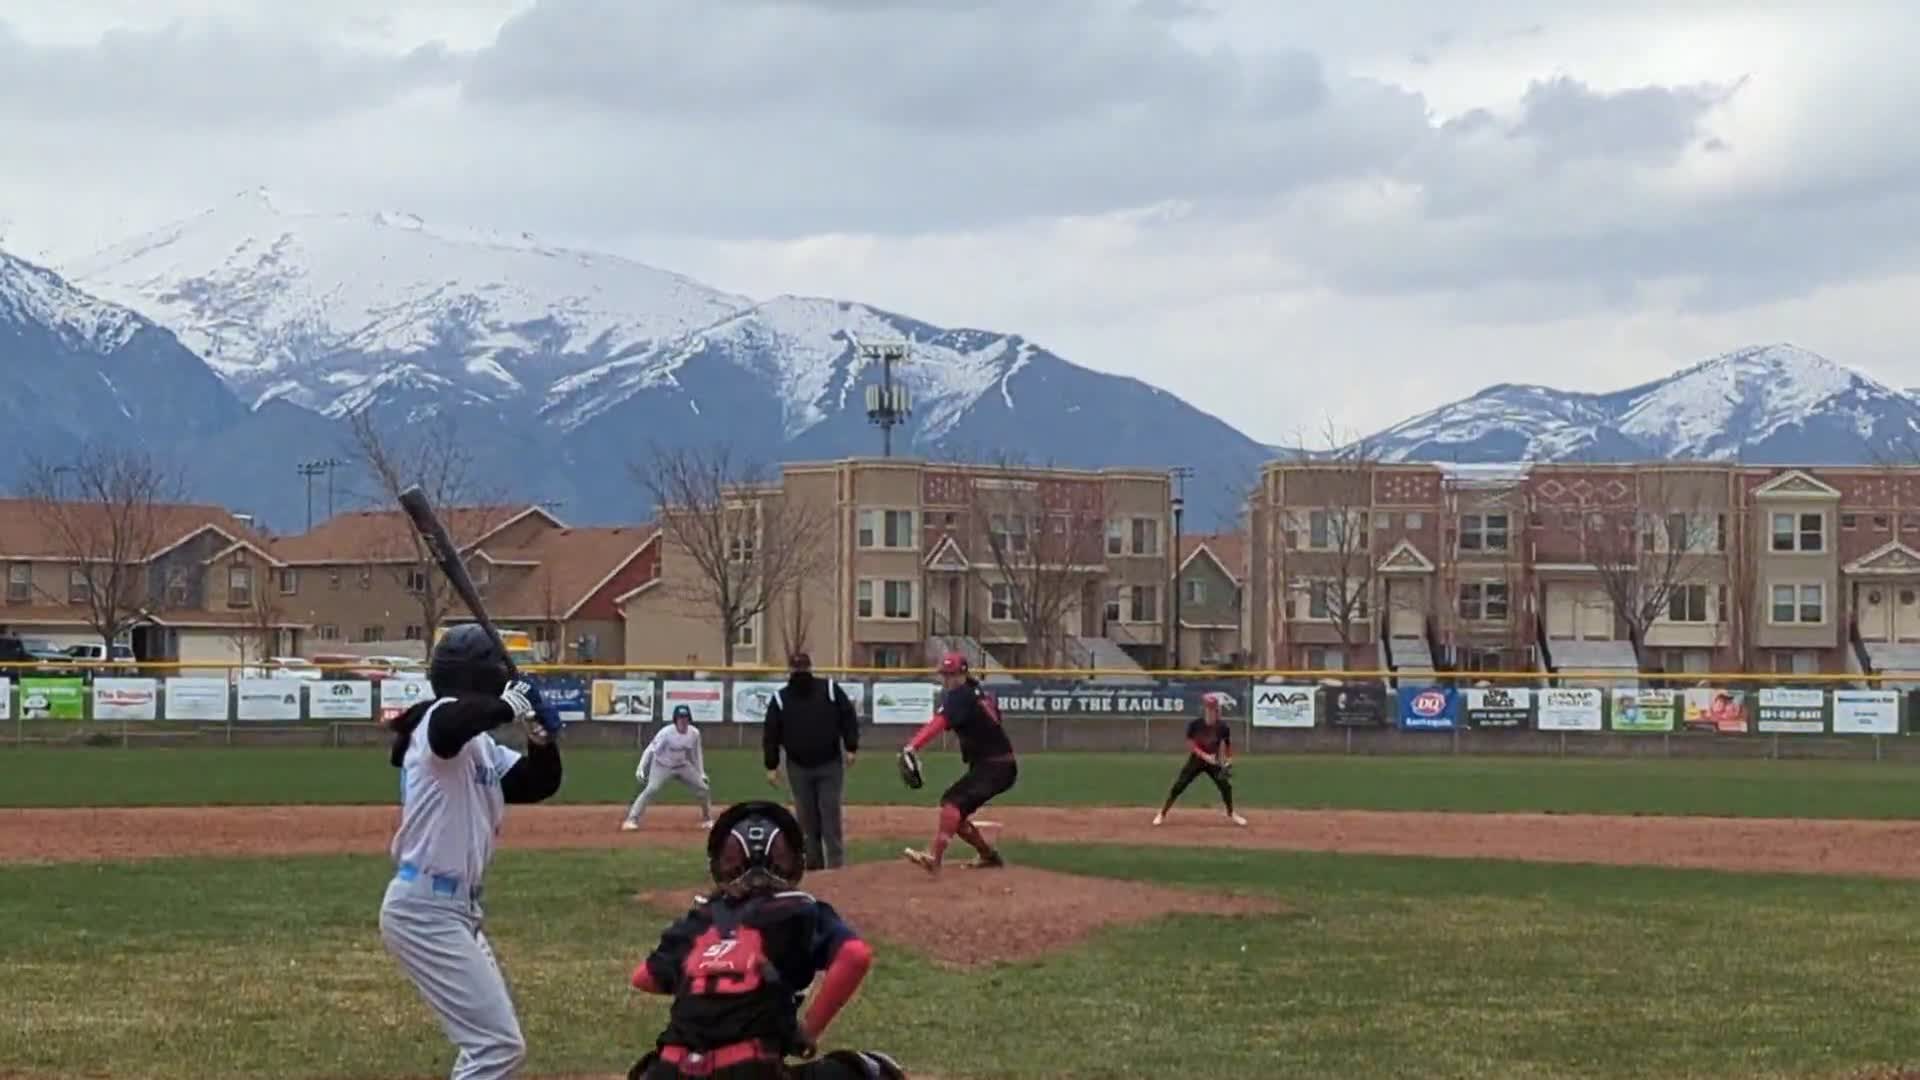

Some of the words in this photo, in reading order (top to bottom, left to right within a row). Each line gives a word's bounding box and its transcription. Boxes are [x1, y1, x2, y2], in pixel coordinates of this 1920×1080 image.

[998, 697, 1045, 711] HOME
[1051, 697, 1071, 711] OF
[1078, 697, 1112, 711] THE
[1117, 697, 1184, 711] EAGLES
[1257, 692, 1309, 704] MVP
[1417, 698, 1440, 710] DQ
